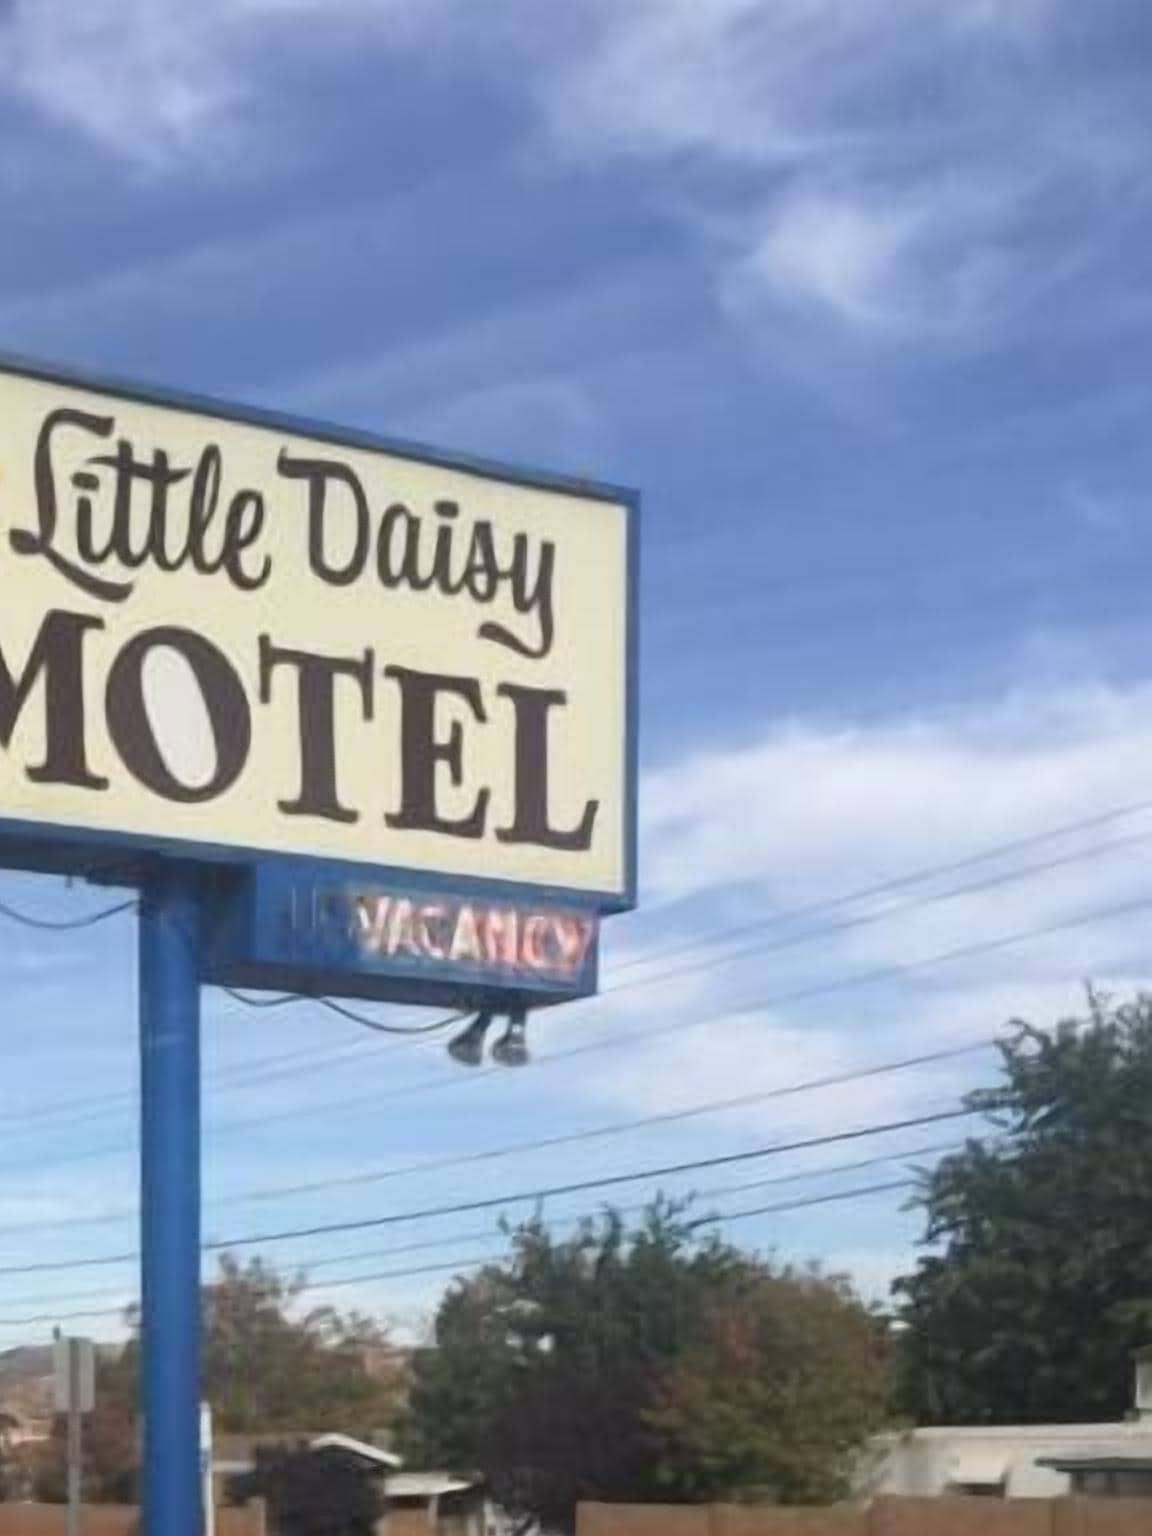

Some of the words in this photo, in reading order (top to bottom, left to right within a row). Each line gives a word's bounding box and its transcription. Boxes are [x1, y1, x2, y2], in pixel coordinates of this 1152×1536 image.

[8, 408, 271, 602] Little
[277, 447, 555, 658] Daisy
[358, 895, 594, 972] VACANCY
